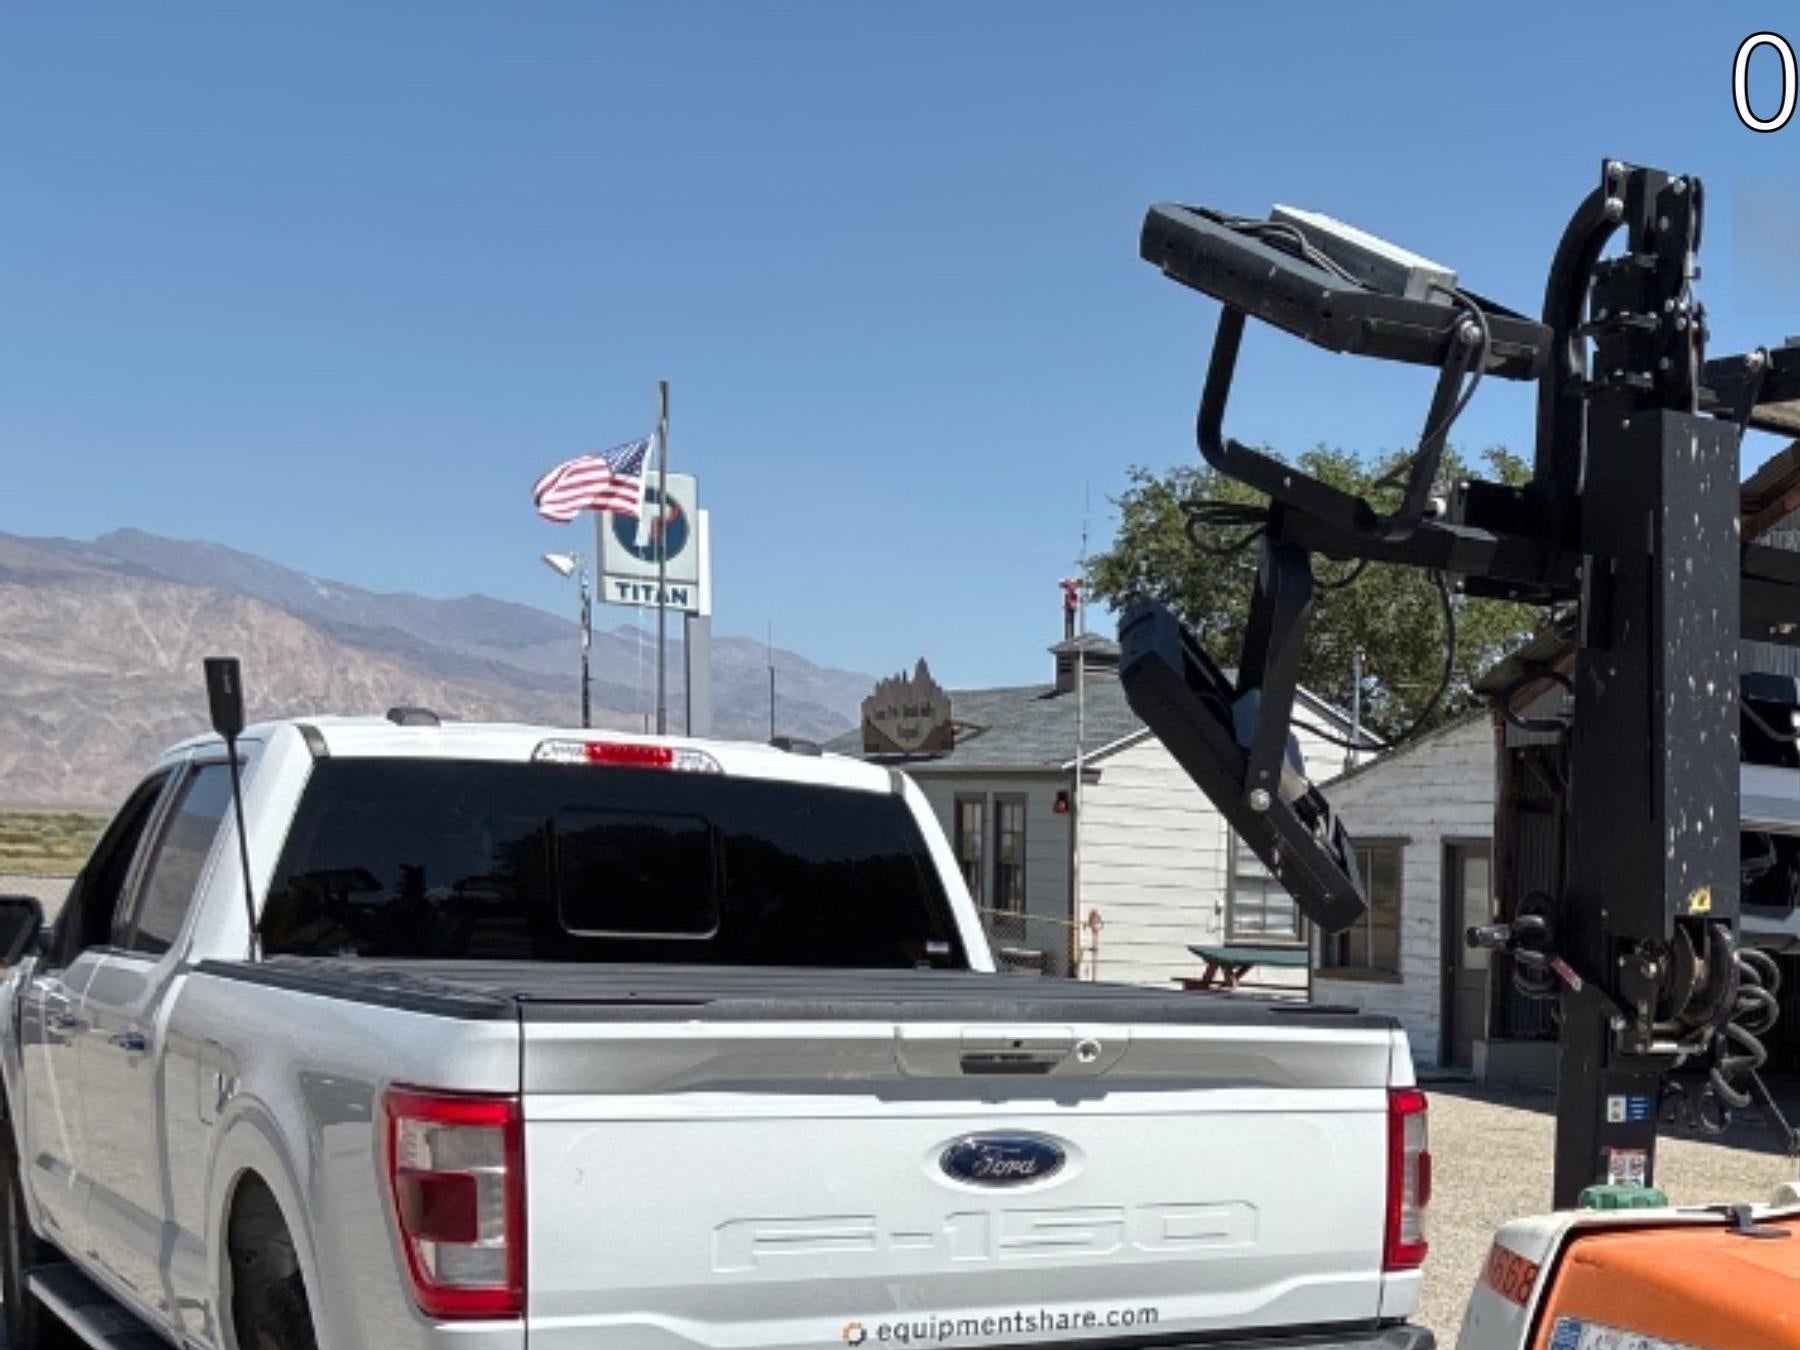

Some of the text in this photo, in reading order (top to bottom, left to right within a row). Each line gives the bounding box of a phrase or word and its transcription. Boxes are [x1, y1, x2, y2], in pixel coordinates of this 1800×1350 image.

[614, 581, 688, 606] TITAN
[973, 1155, 1036, 1177] Ford
[711, 1199, 1259, 1274] F-150
[875, 1306, 1160, 1343] equipmentshare.com
